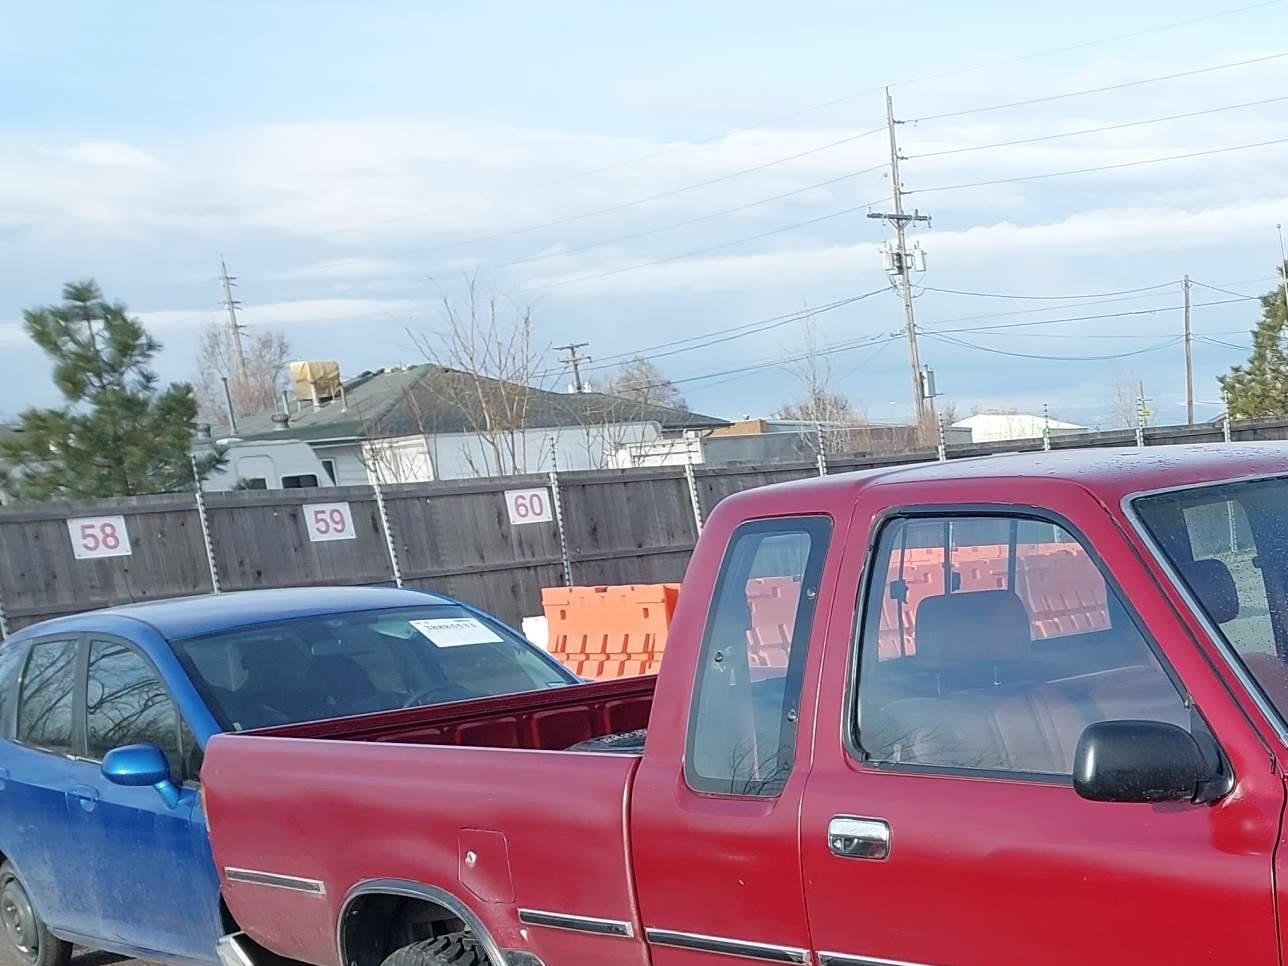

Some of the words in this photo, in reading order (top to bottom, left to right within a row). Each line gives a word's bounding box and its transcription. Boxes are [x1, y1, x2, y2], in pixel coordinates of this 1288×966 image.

[513, 493, 544, 518] 60
[313, 508, 346, 535] 59
[80, 522, 120, 552] 58
